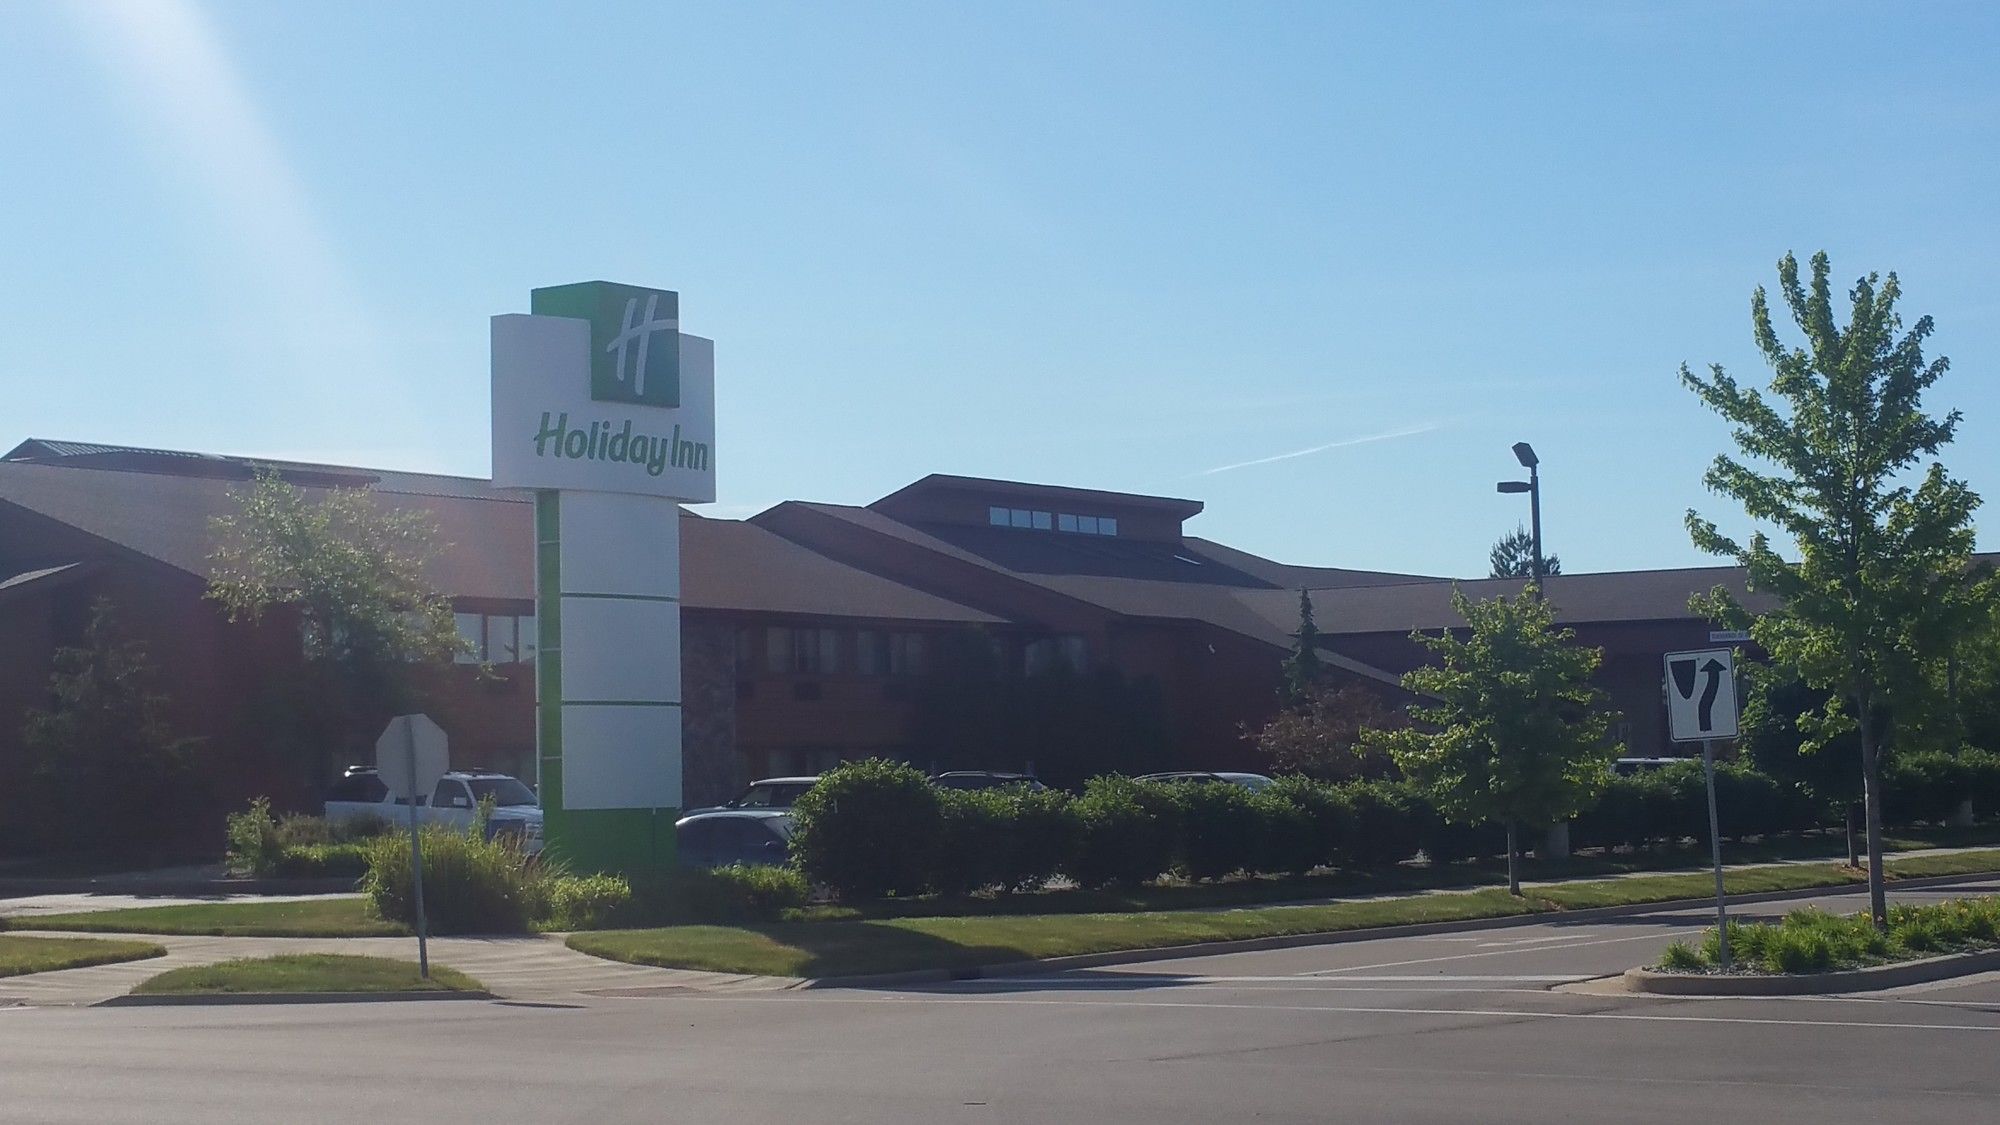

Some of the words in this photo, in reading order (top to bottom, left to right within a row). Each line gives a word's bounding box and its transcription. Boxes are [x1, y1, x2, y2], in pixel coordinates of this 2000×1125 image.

[606, 294, 678, 396] H
[533, 412, 668, 476] Holiday
[670, 423, 708, 472] Inn
